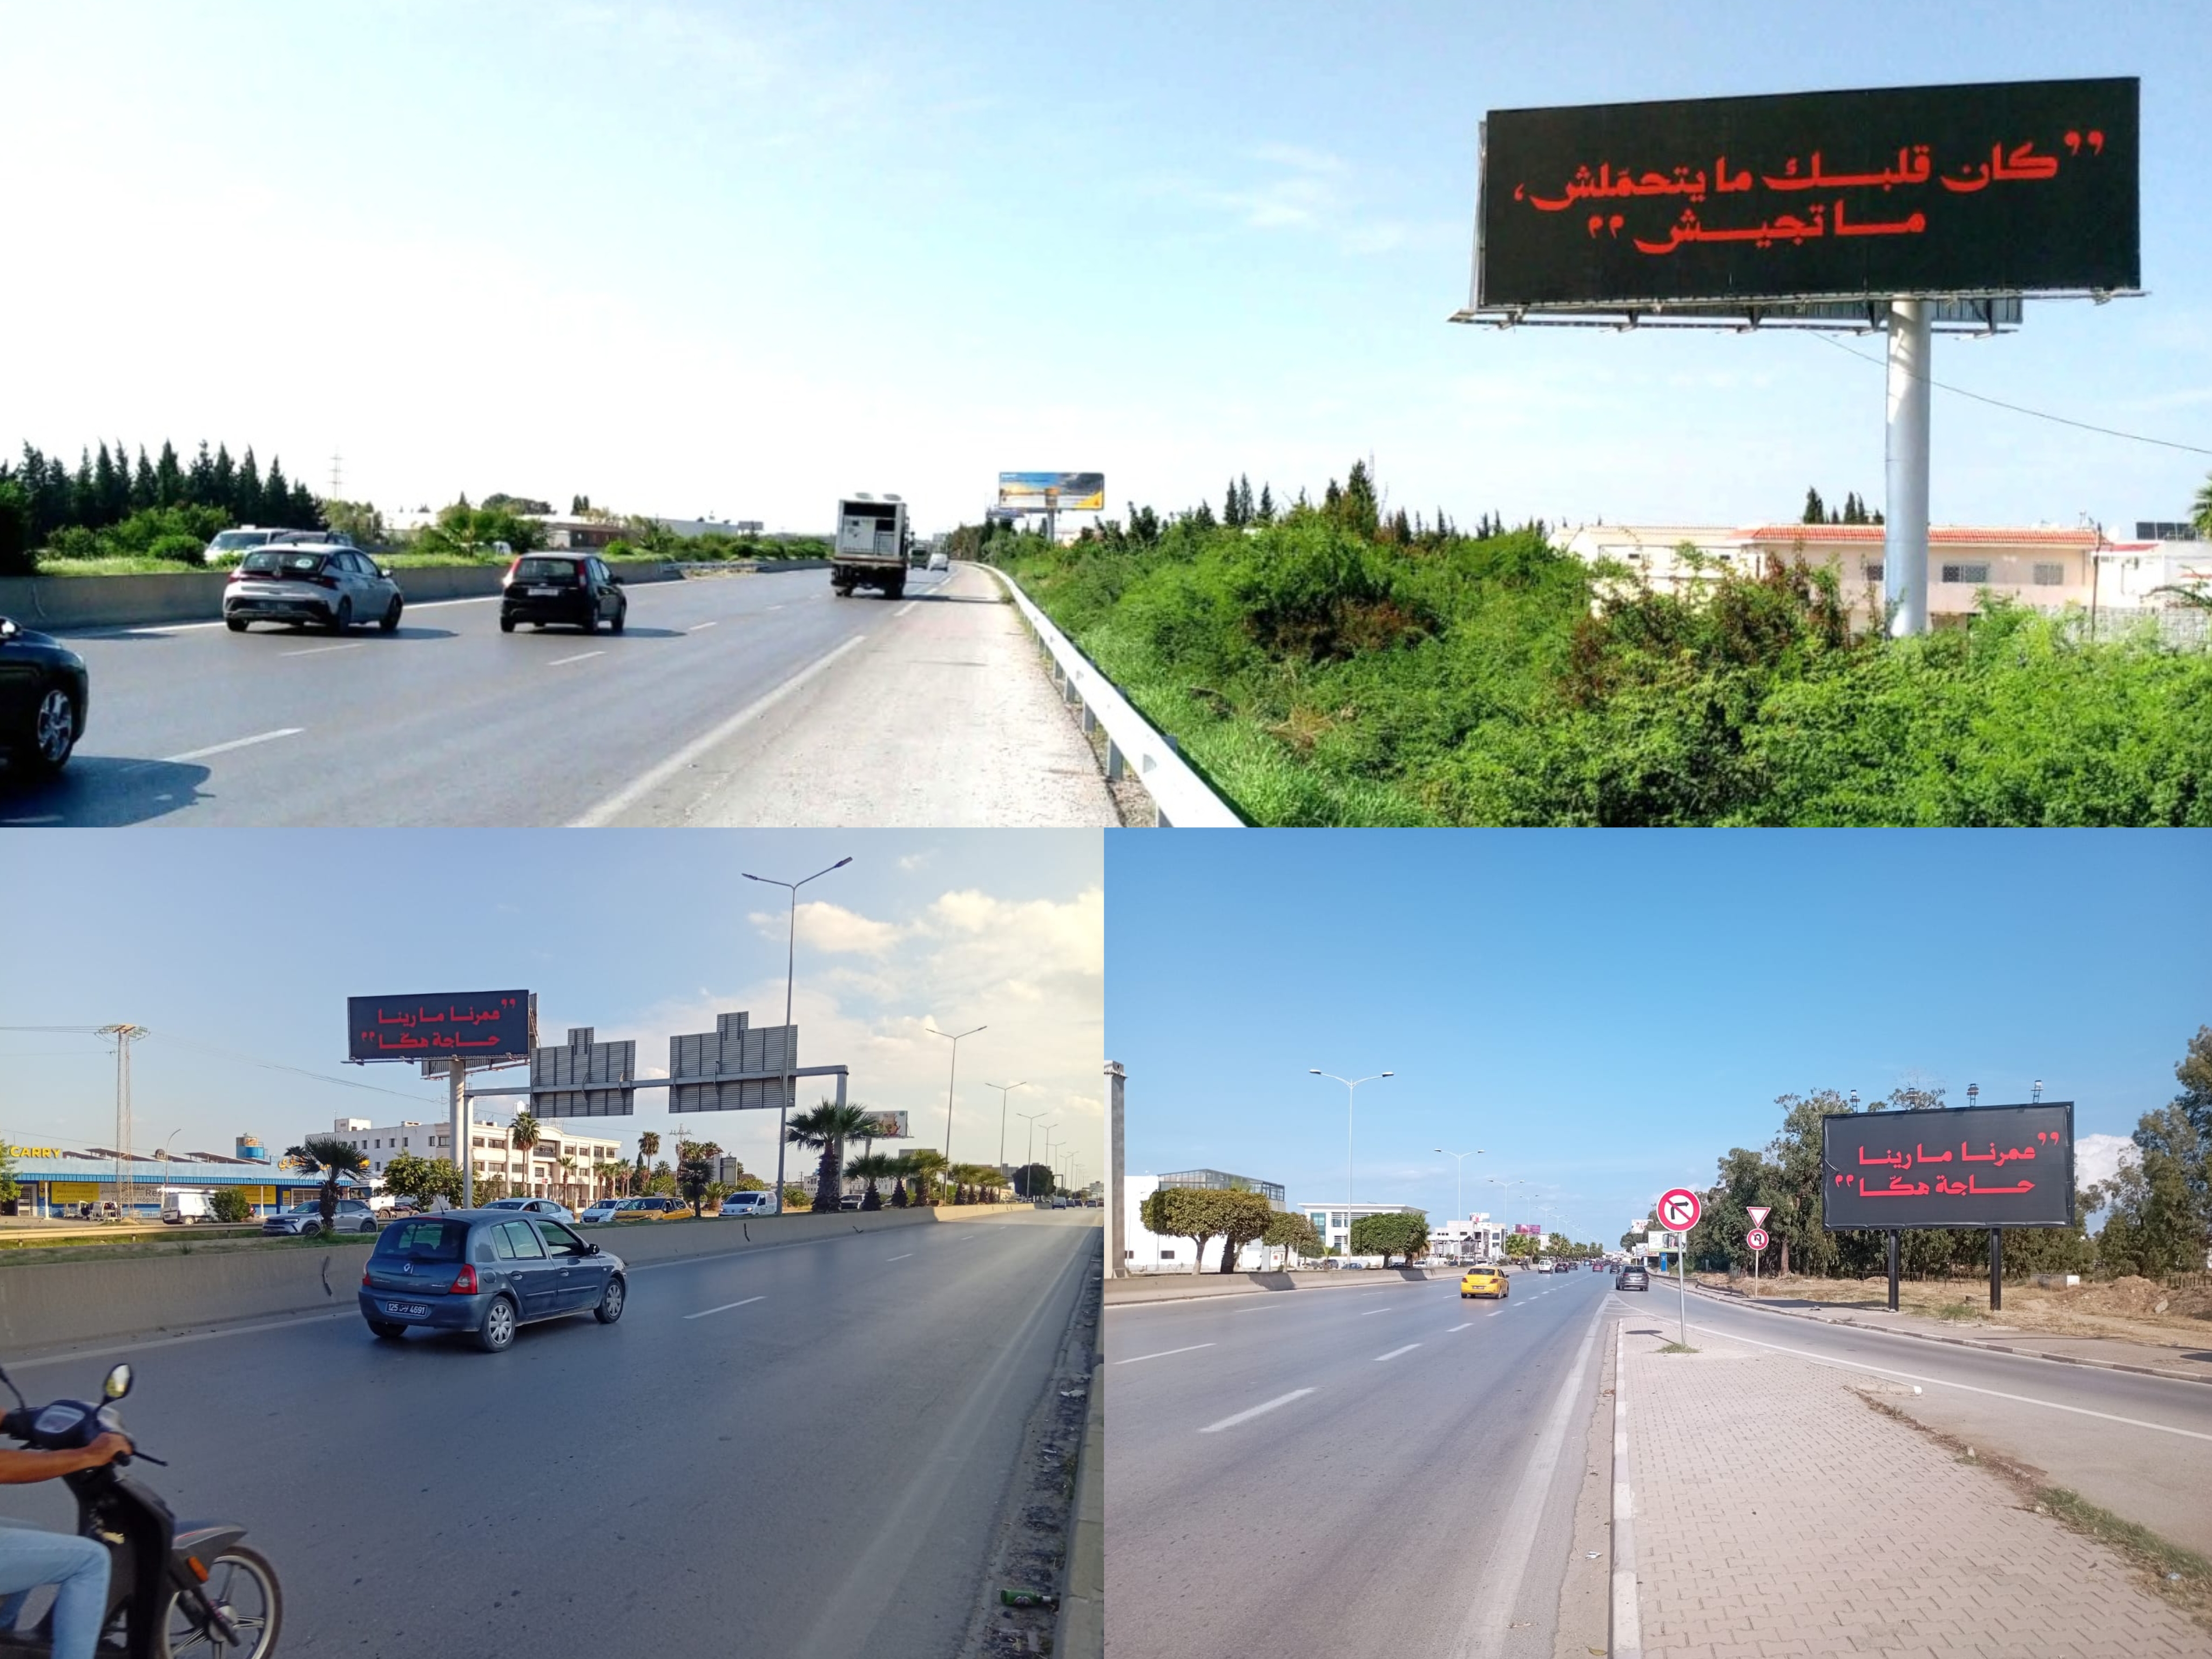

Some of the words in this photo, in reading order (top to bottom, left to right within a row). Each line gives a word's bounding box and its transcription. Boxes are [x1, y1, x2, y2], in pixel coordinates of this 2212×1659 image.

[1761, 144, 1933, 192] قلبك
[433, 1031, 500, 1048] حاجة
[10, 1146, 61, 1158] CARRY
[1858, 1146, 1913, 1170] رينا
[1935, 1174, 2036, 1197] حاجة
[388, 1303, 399, 1311] 125
[409, 1305, 425, 1314] 4691
